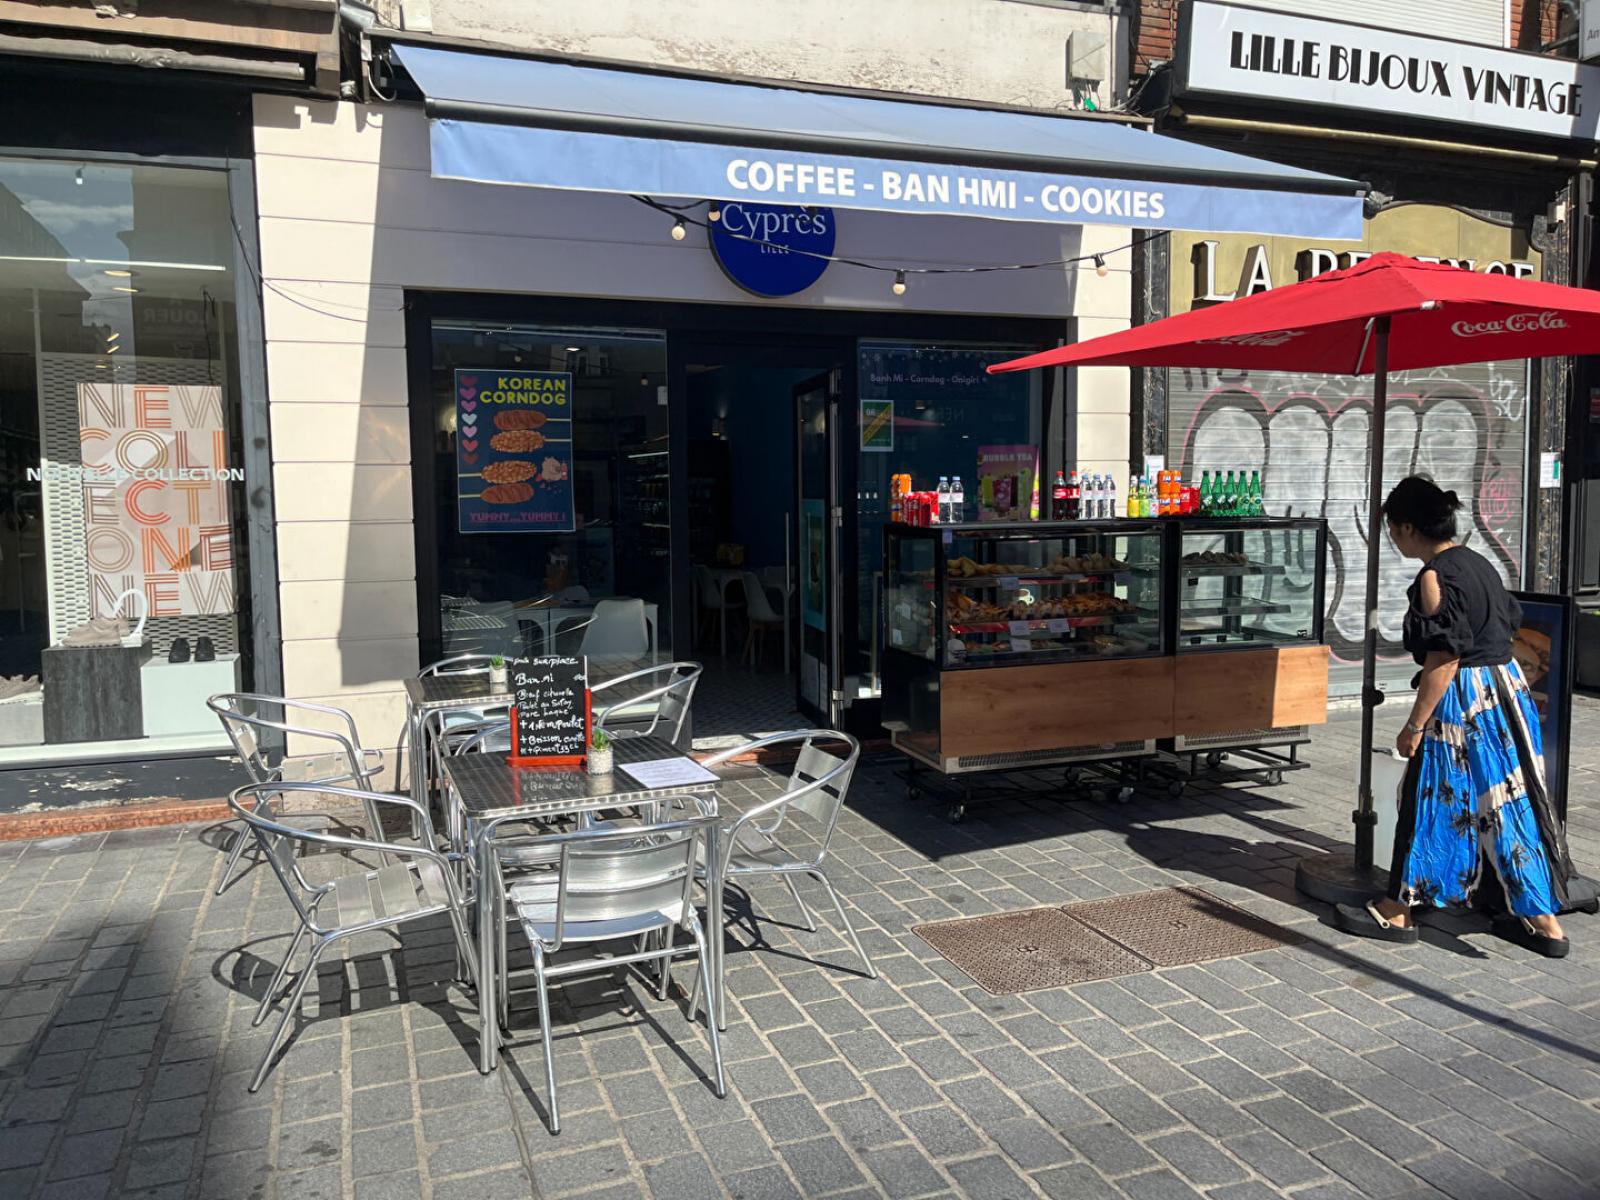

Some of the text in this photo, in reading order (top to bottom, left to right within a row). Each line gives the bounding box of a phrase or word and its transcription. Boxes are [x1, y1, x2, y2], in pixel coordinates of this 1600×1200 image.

[1230, 31, 1582, 117] LILLE BIJOUX VINTAGE
[727, 159, 856, 197] COFFEE
[882, 171, 950, 203] BAN
[958, 177, 1017, 209] HMI
[1041, 184, 1166, 219] COOKIES
[721, 203, 827, 241] Cyprès
[1192, 240, 1274, 302] LA
[1451, 311, 1568, 338] Coca-Cola
[498, 377, 566, 391] KOREAN
[870, 374, 892, 383] Banh
[480, 391, 566, 405] CORNDOG
[132, 468, 244, 481] COLLECTION
